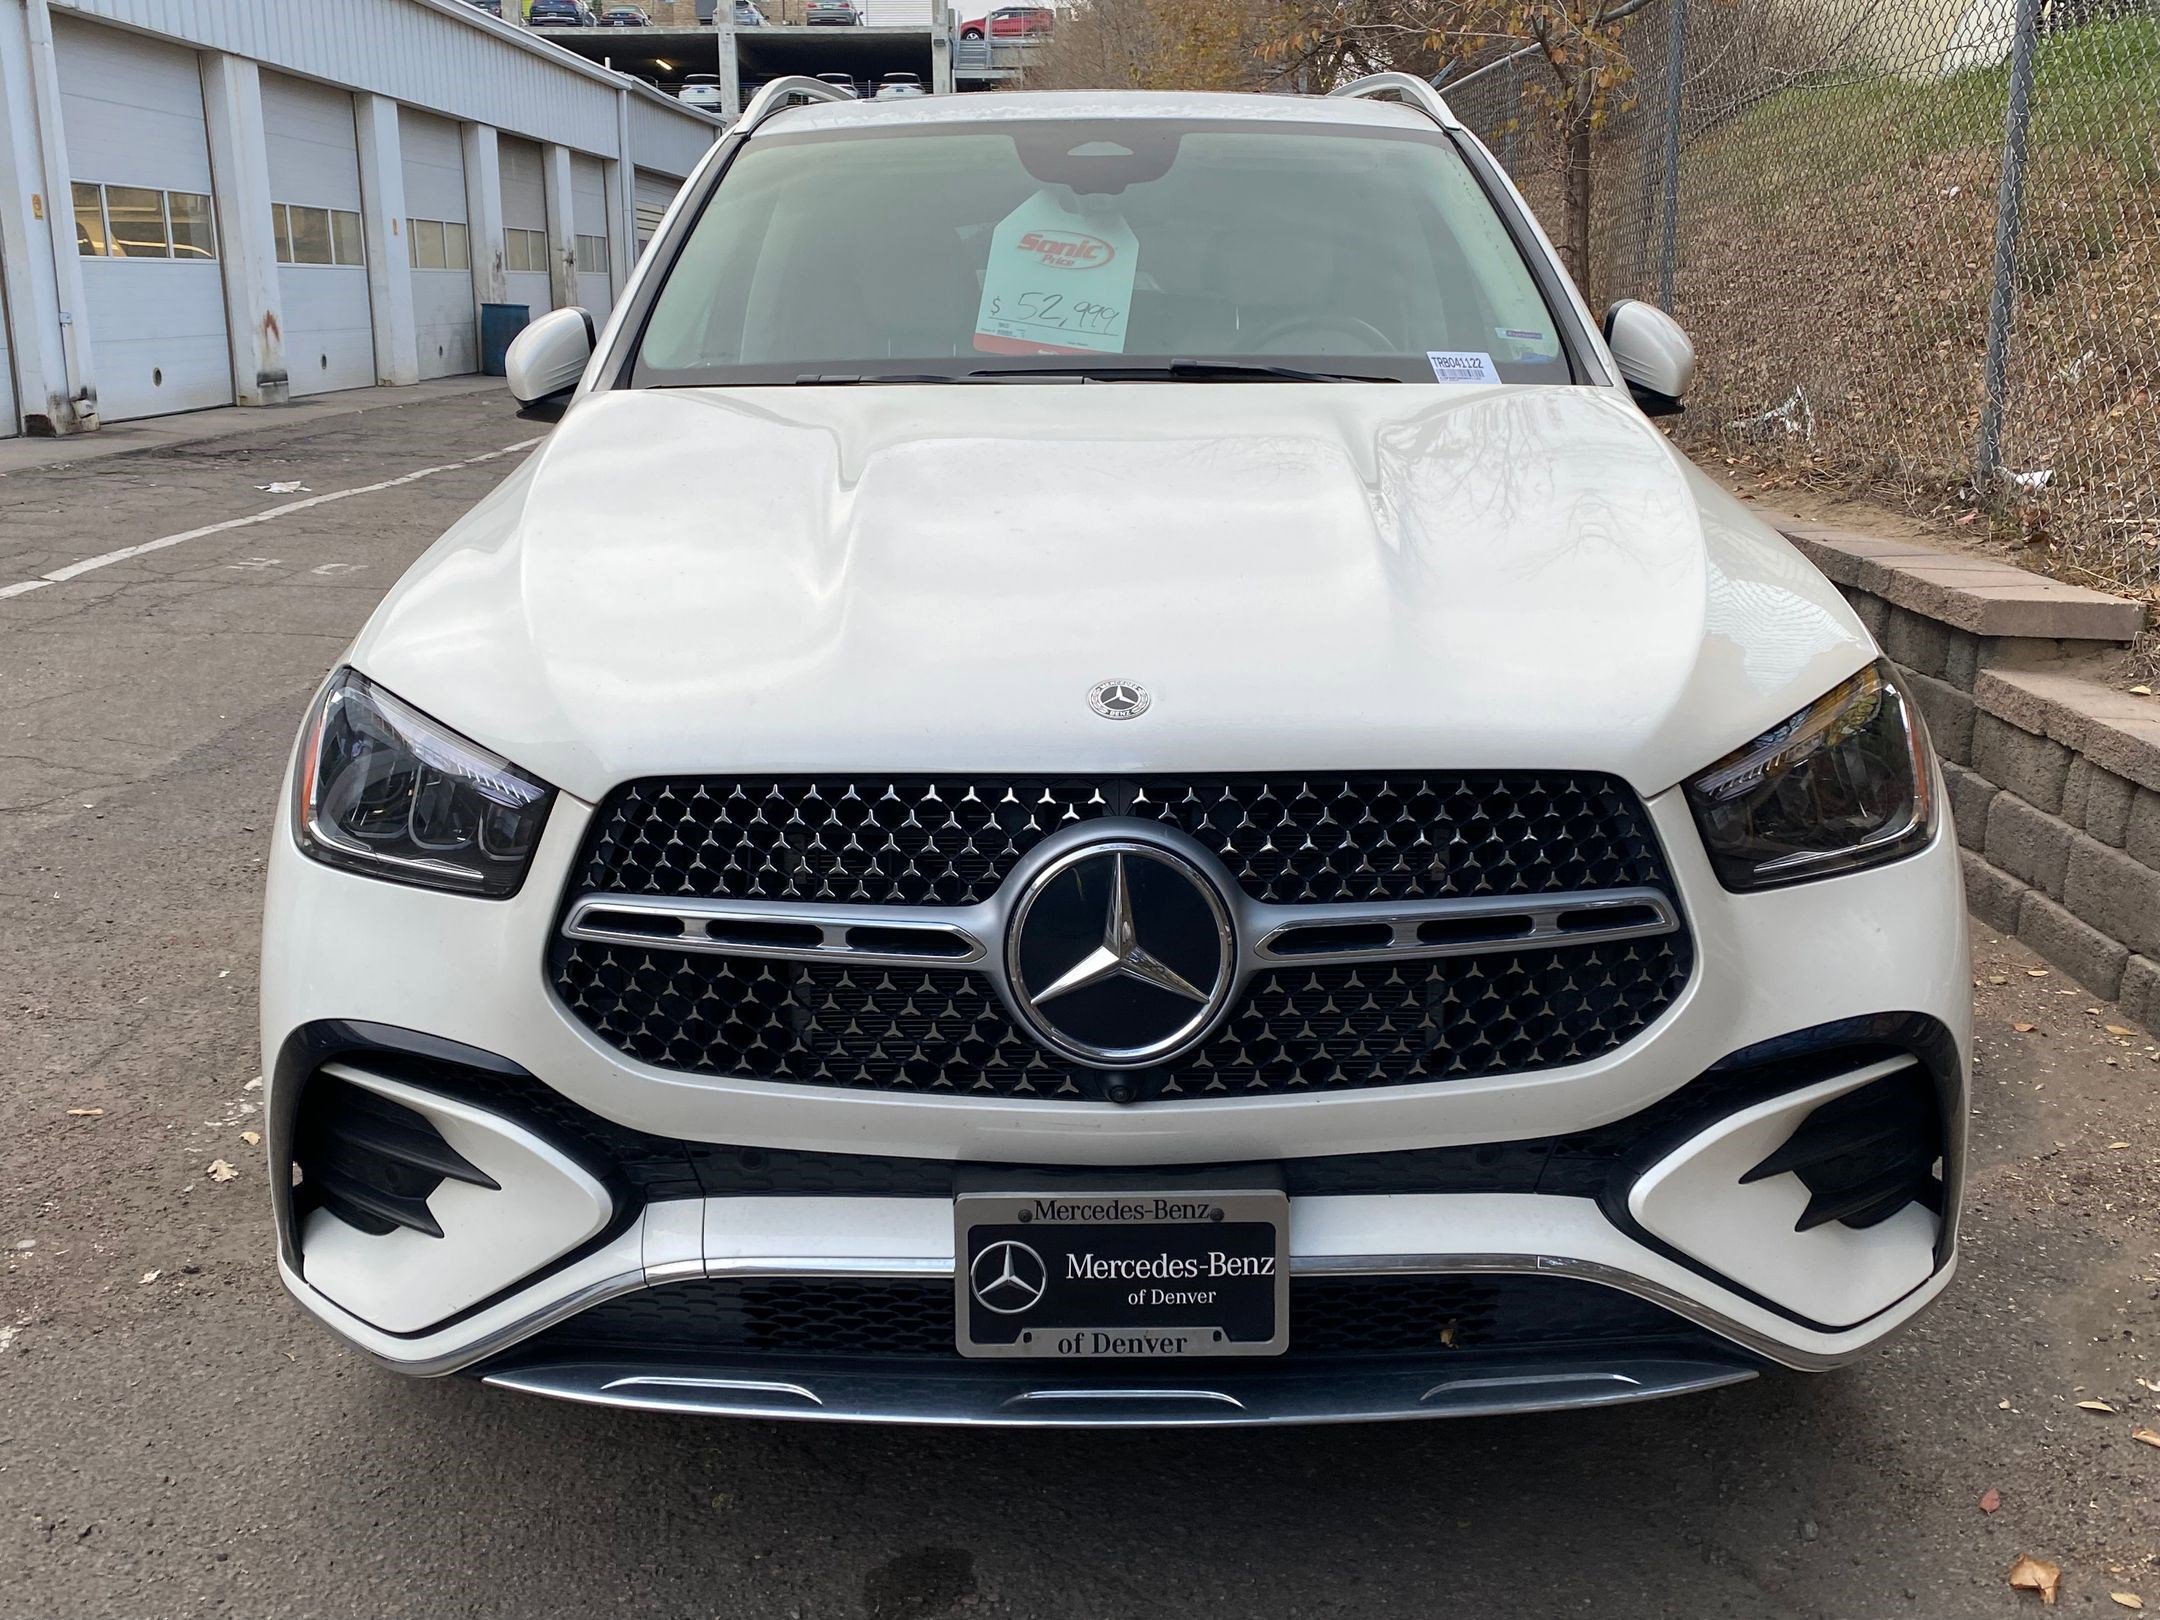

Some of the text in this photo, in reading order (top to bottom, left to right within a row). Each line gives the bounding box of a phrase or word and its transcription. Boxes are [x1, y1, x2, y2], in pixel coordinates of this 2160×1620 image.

[1017, 233, 1103, 259] Sonic
[1042, 254, 1075, 267] Price
[990, 292, 1120, 334] $ 52,999
[1431, 357, 1484, 369] TRB041122
[1034, 1199, 1211, 1221] Mercedes-Benz
[1066, 1252, 1275, 1279] Mercedes-Benz
[1127, 1289, 1217, 1305] of Denver
[1058, 1332, 1188, 1355] of Denver
